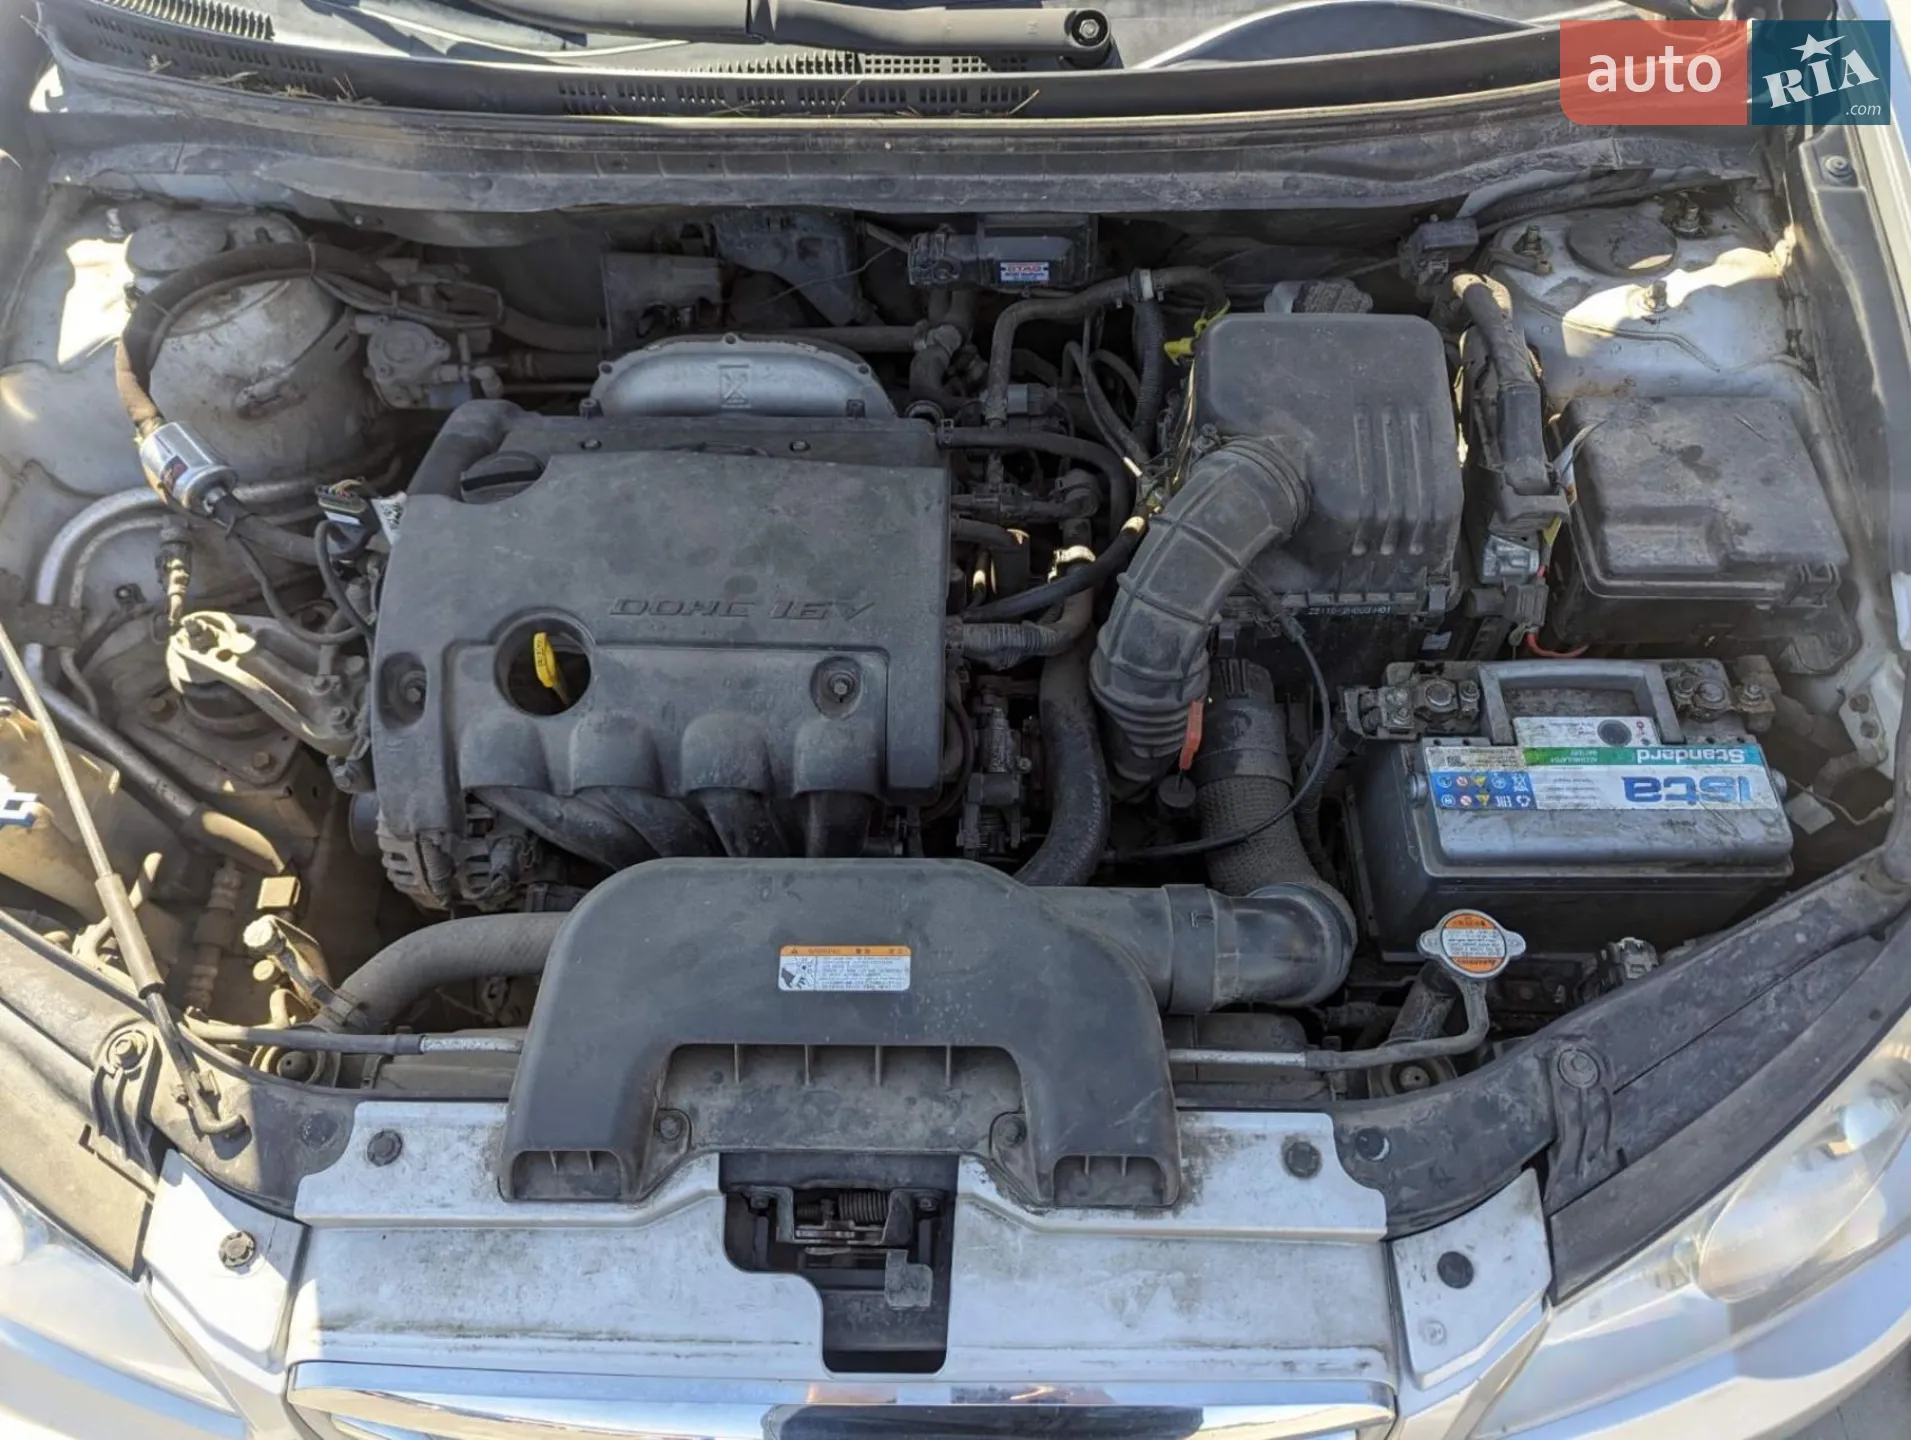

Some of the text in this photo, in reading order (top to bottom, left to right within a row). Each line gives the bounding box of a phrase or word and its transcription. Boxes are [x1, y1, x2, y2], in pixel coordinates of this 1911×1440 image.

[609, 598, 876, 621] DOHC 16V
[1636, 749, 1745, 764] Standard
[1621, 775, 1751, 804] ista
